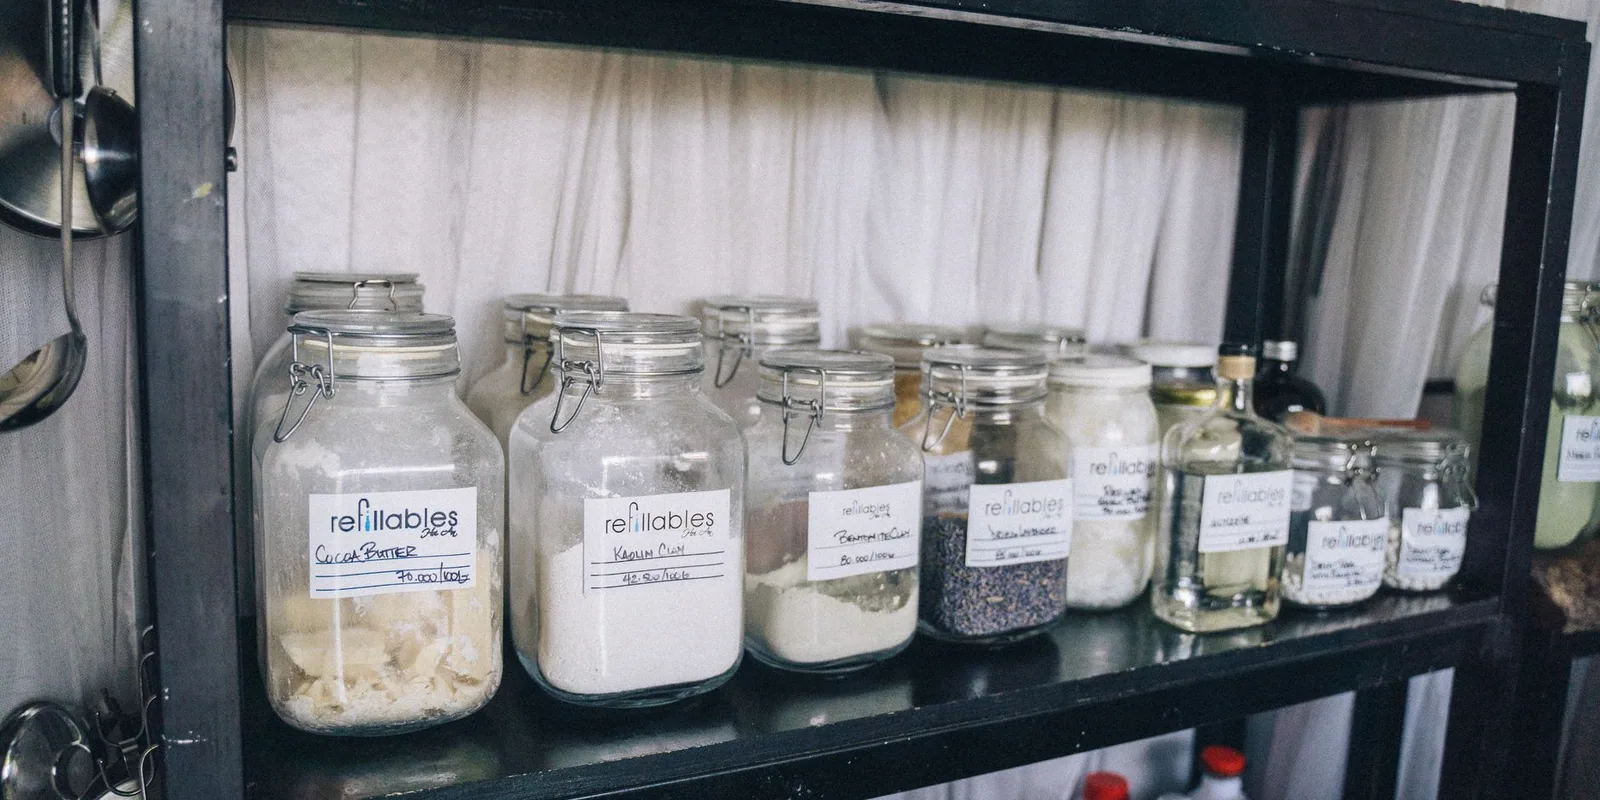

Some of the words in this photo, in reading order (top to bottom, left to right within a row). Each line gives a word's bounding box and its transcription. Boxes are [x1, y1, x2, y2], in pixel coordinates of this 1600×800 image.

[330, 498, 458, 533] refillables
[605, 502, 714, 534] refillables
[842, 500, 891, 516] refillables
[984, 490, 1063, 517] refillables
